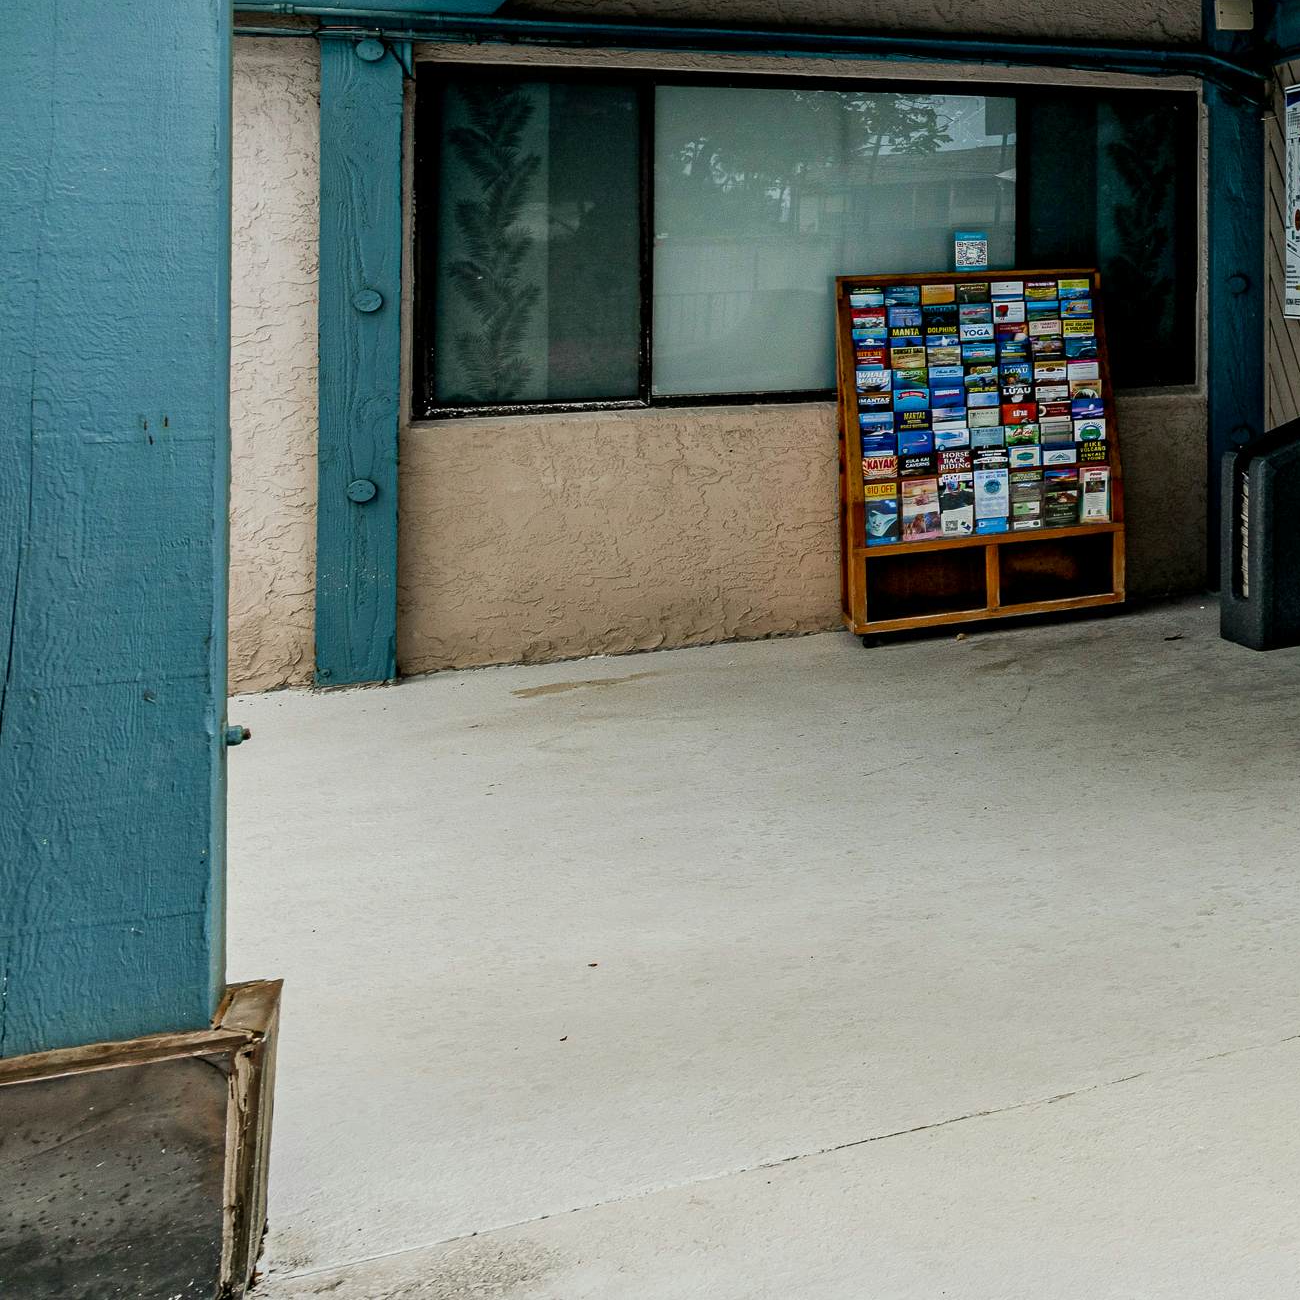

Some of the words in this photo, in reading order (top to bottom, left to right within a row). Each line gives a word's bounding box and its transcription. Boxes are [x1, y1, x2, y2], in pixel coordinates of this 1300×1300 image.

[892, 327, 920, 336] MANTA
[927, 326, 957, 334] DOLPHINS
[963, 329, 990, 337] YOGA
[867, 460, 895, 470] KAYAK
[940, 462, 971, 471] RIDING
[867, 486, 879, 495] $10
[880, 484, 894, 493] OFF
